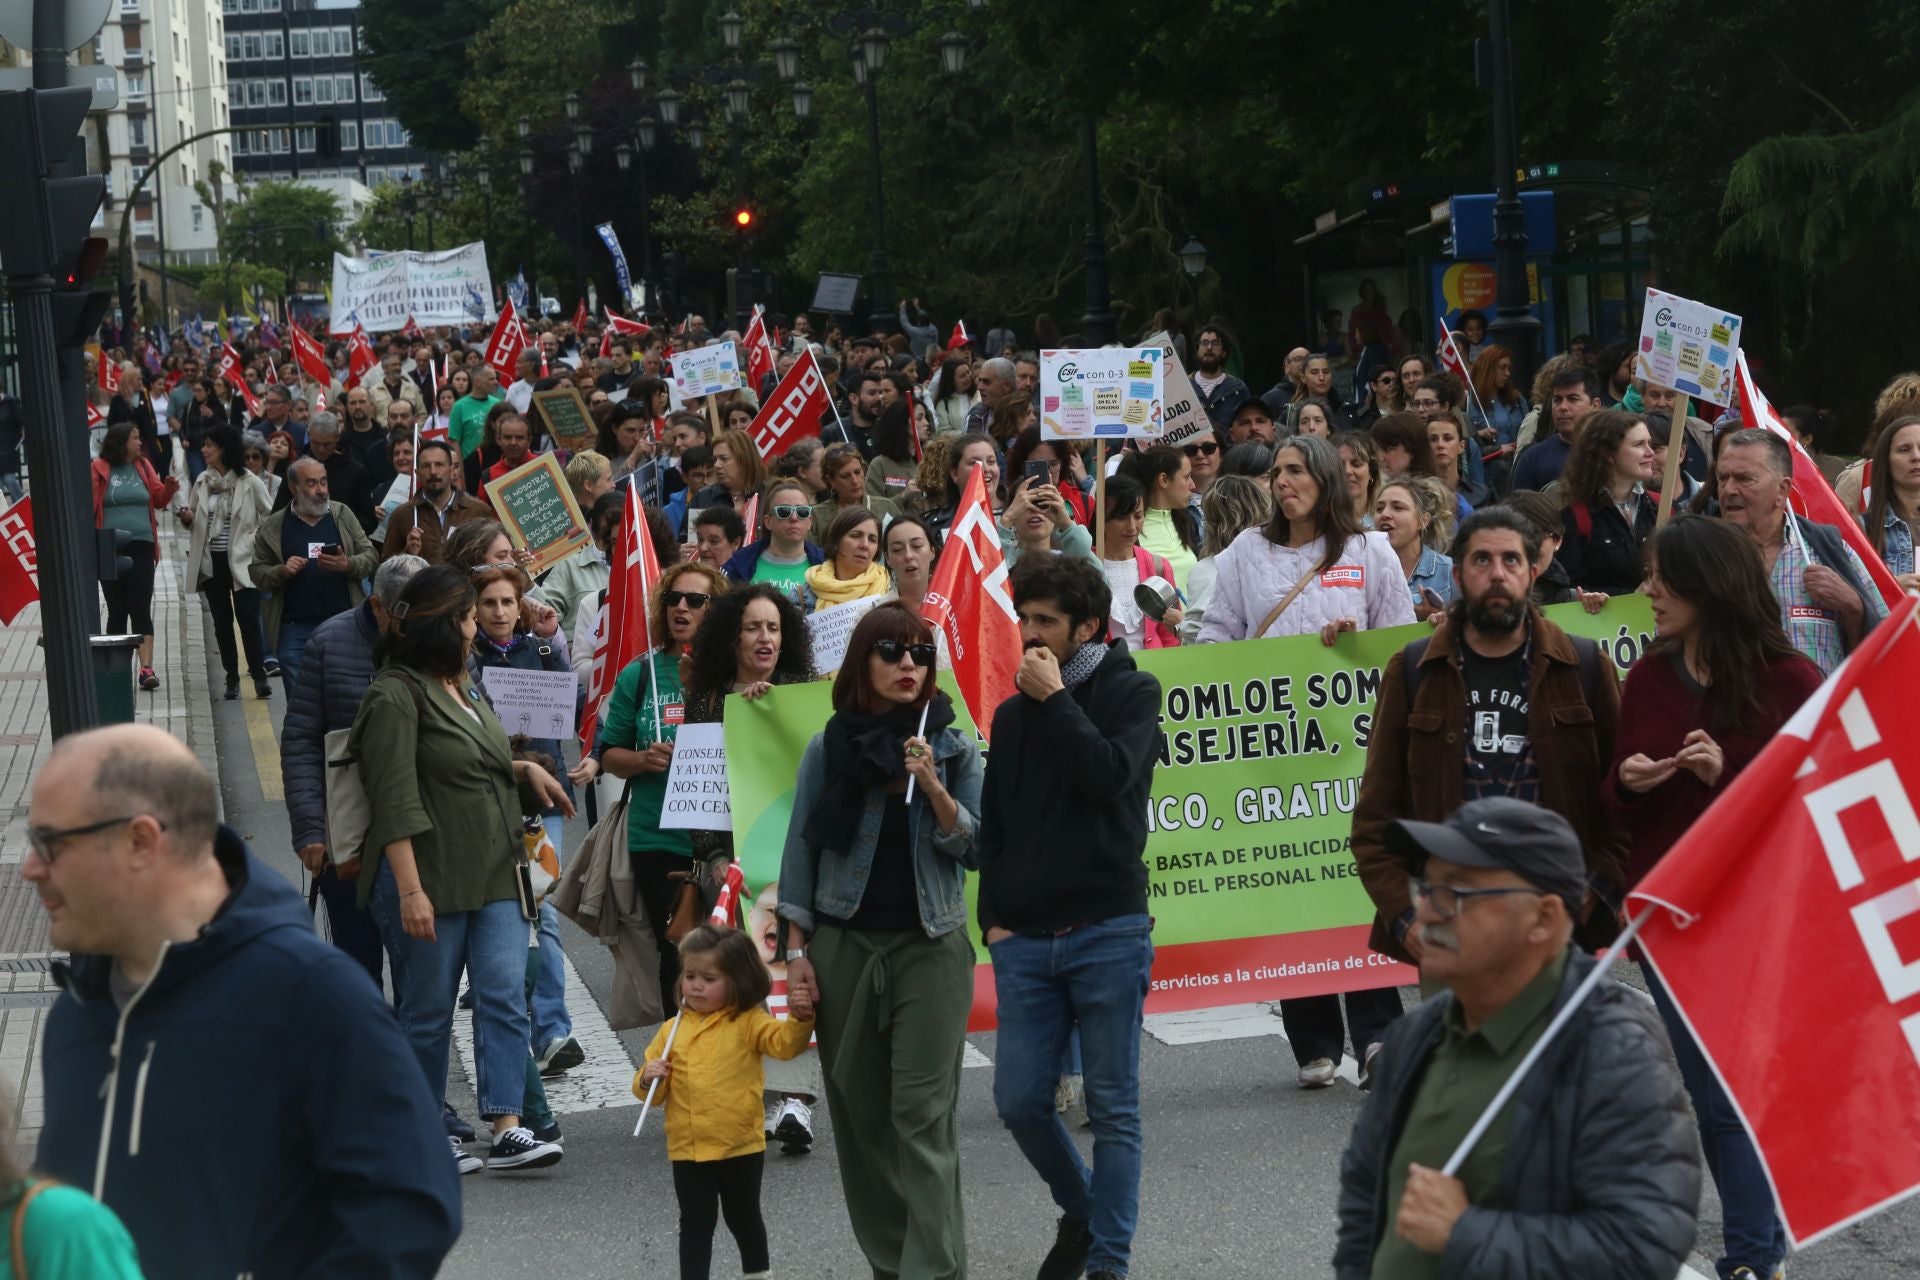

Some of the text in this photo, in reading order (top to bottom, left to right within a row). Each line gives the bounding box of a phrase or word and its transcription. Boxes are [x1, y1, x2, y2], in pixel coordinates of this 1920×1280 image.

[1678, 322, 1693, 333] con
[1695, 326, 1708, 338] 0-3
[492, 312, 520, 366] CCO
[1086, 370, 1104, 378] con
[1108, 370, 1124, 378] 0-3
[754, 366, 820, 458] CCOO
[1148, 421, 1200, 446] ABORAL
[504, 471, 550, 502] SI NOSOTRAS
[513, 481, 550, 508] NO SOMOS
[530, 498, 541, 507] DE
[1793, 608, 1822, 616] CCOO
[822, 630, 843, 641] PARO
[815, 640, 842, 653] MALAS
[644, 692, 684, 709] ESUELA
[1158, 678, 1293, 723] OMLOE
[1490, 689, 1528, 714] FORG
[678, 748, 726, 760] CONSEJE
[676, 764, 727, 775] Y AYUNT
[672, 781, 698, 794] NOS
[668, 800, 698, 812] CON
[1156, 851, 1218, 871] BASTA
[1223, 849, 1247, 864] DE
[1252, 837, 1352, 862] PUBLICIDA
[1174, 879, 1208, 896] DEL
[1215, 868, 1316, 892] PERSONAL
[1152, 974, 1219, 991] servicios
[1224, 972, 1233, 984] a
[1236, 968, 1250, 981] la
[1255, 954, 1340, 979] ciudadanía
[1344, 956, 1364, 969] de
